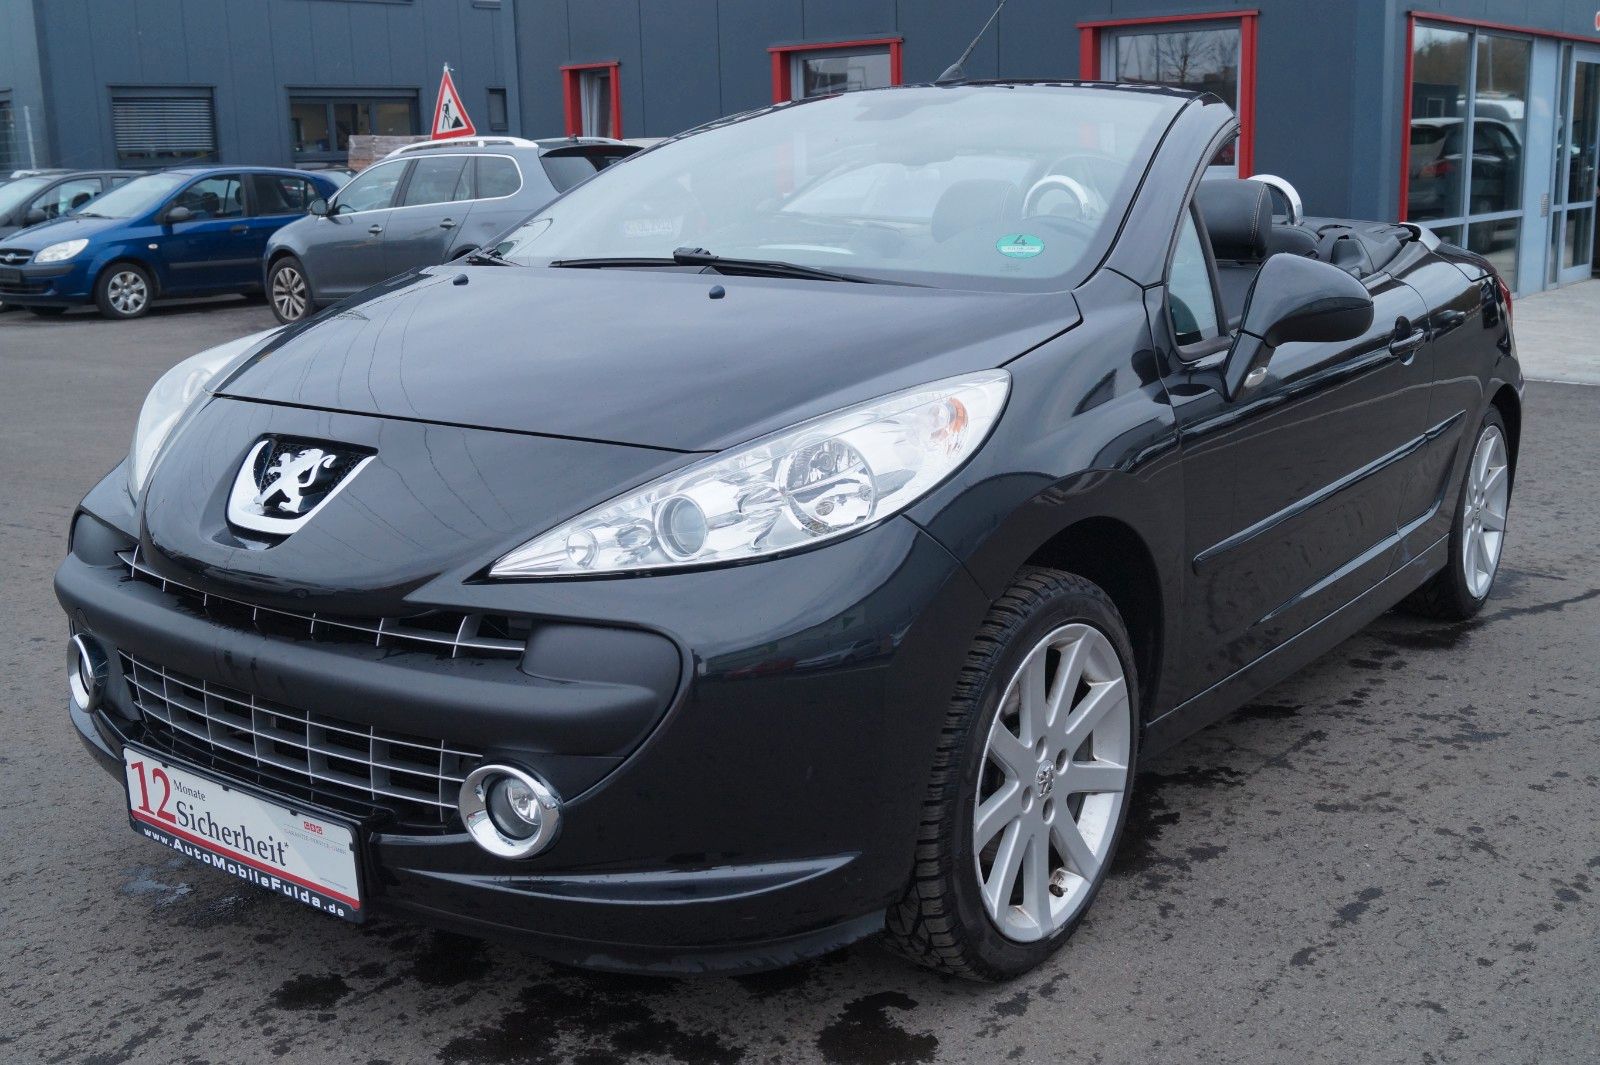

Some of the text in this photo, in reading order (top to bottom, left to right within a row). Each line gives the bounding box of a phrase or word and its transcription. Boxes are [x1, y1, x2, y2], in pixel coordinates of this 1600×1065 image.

[1013, 234, 1028, 246] 4
[131, 761, 206, 825] 12 Monate
[143, 827, 345, 917] www.AutoMobileFulda.de
